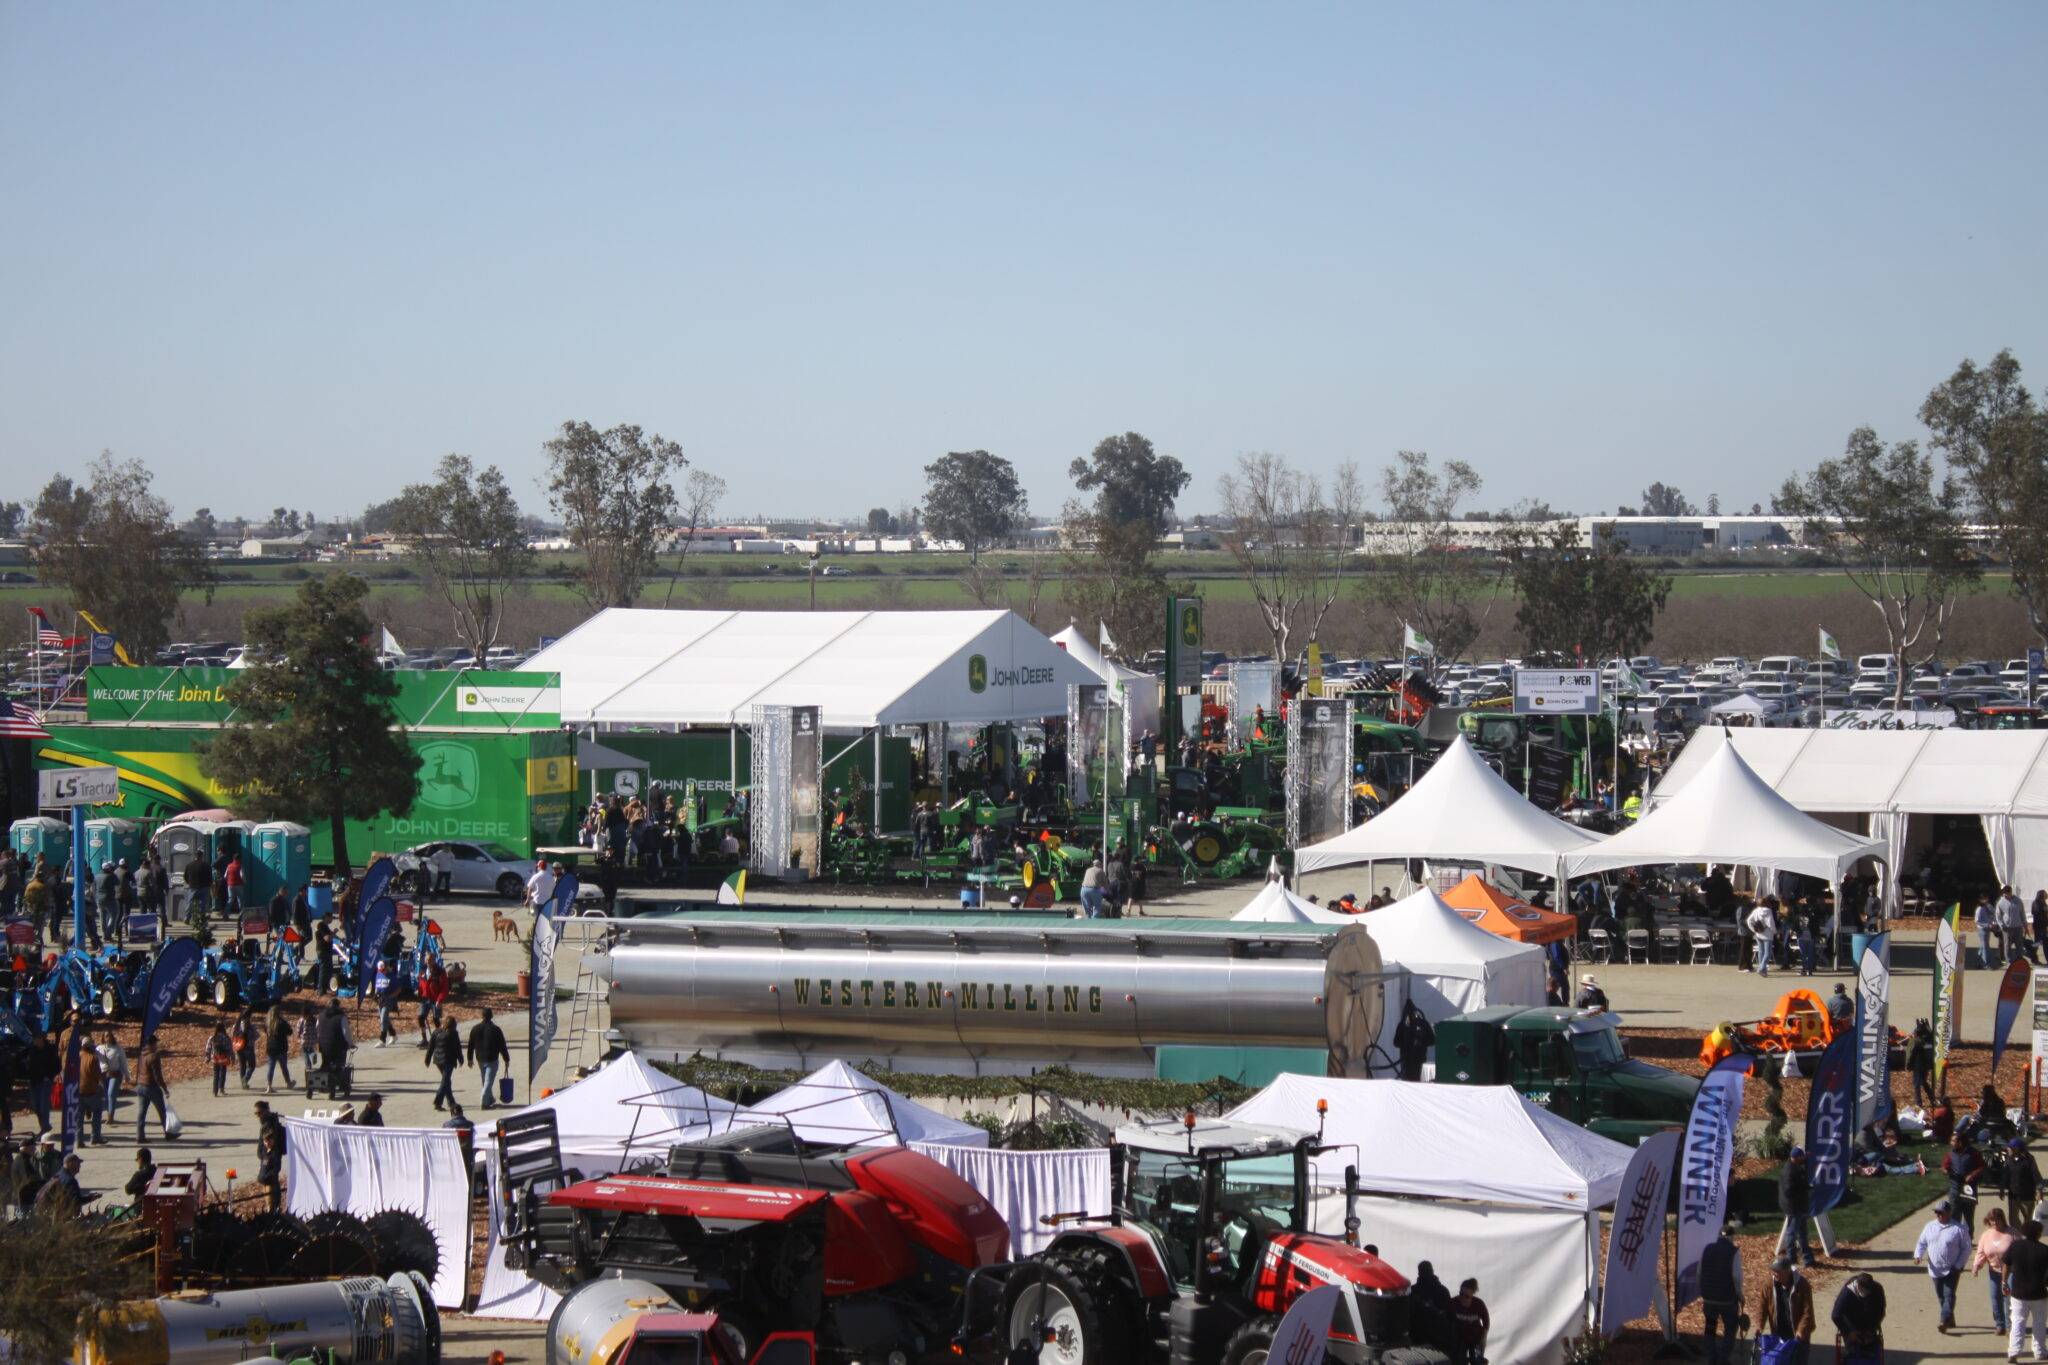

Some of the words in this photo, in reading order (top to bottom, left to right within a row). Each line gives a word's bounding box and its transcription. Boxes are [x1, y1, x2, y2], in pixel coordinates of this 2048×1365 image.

[93, 688, 139, 700] WELCOME
[142, 689, 156, 701] TO
[157, 689, 175, 701] THE
[177, 685, 210, 702] John
[990, 667, 1020, 686] JOHN
[1021, 666, 1055, 685] DEERE
[481, 696, 500, 704] JOHN
[501, 696, 526, 704] DEERE
[55, 778, 78, 798] LS
[80, 781, 118, 798] Tractor
[384, 818, 439, 834] JOHN
[443, 819, 510, 836] DEERE
[364, 945, 379, 970] LS
[375, 914, 392, 947] Tractor
[152, 985, 172, 1013] LS
[168, 957, 195, 992] Tractor
[534, 935, 553, 1051] WALINGA
[794, 978, 943, 1009] WESTERN
[961, 982, 1102, 1014] MILLING
[1859, 973, 1883, 1104] WALINGA
[1683, 1085, 1726, 1226] WINNER
[1815, 1091, 1846, 1186] BURR
[1298, 1258, 1330, 1280] FERGUSON
